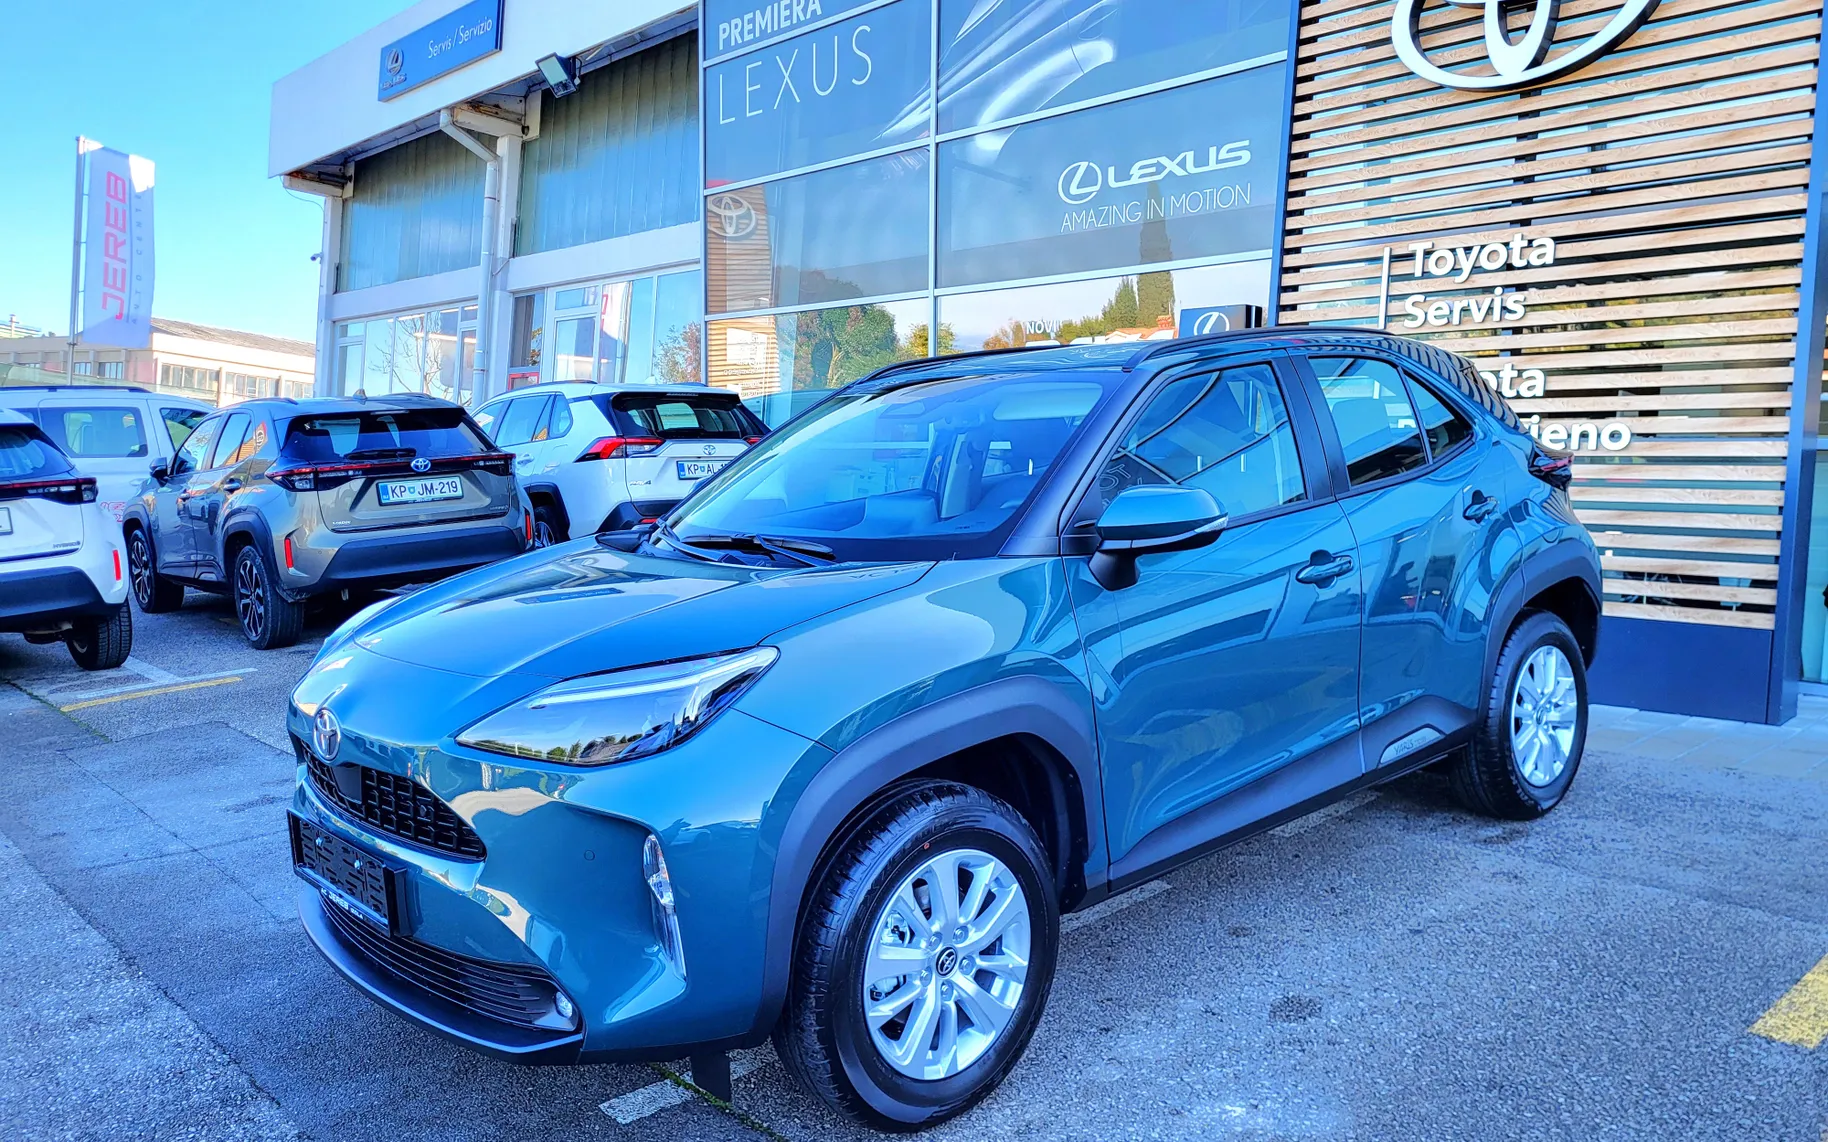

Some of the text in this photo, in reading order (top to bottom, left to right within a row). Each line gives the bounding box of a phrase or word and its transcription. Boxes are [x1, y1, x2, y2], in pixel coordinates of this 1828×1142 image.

[428, 35, 452, 59] Servis
[459, 17, 493, 44] Servizio
[719, 0, 822, 50] PREMIERA
[719, 25, 872, 125] LEXUS
[1107, 140, 1251, 188] LEXUS
[1060, 182, 1251, 233] AMAZING IN MOTION
[102, 170, 127, 321] JEREB
[1408, 232, 1556, 284] Toyota
[1403, 286, 1526, 329] Servis
[1480, 362, 1546, 398] ota
[390, 480, 459, 499] KP JM-219
[687, 463, 699, 475] KP
